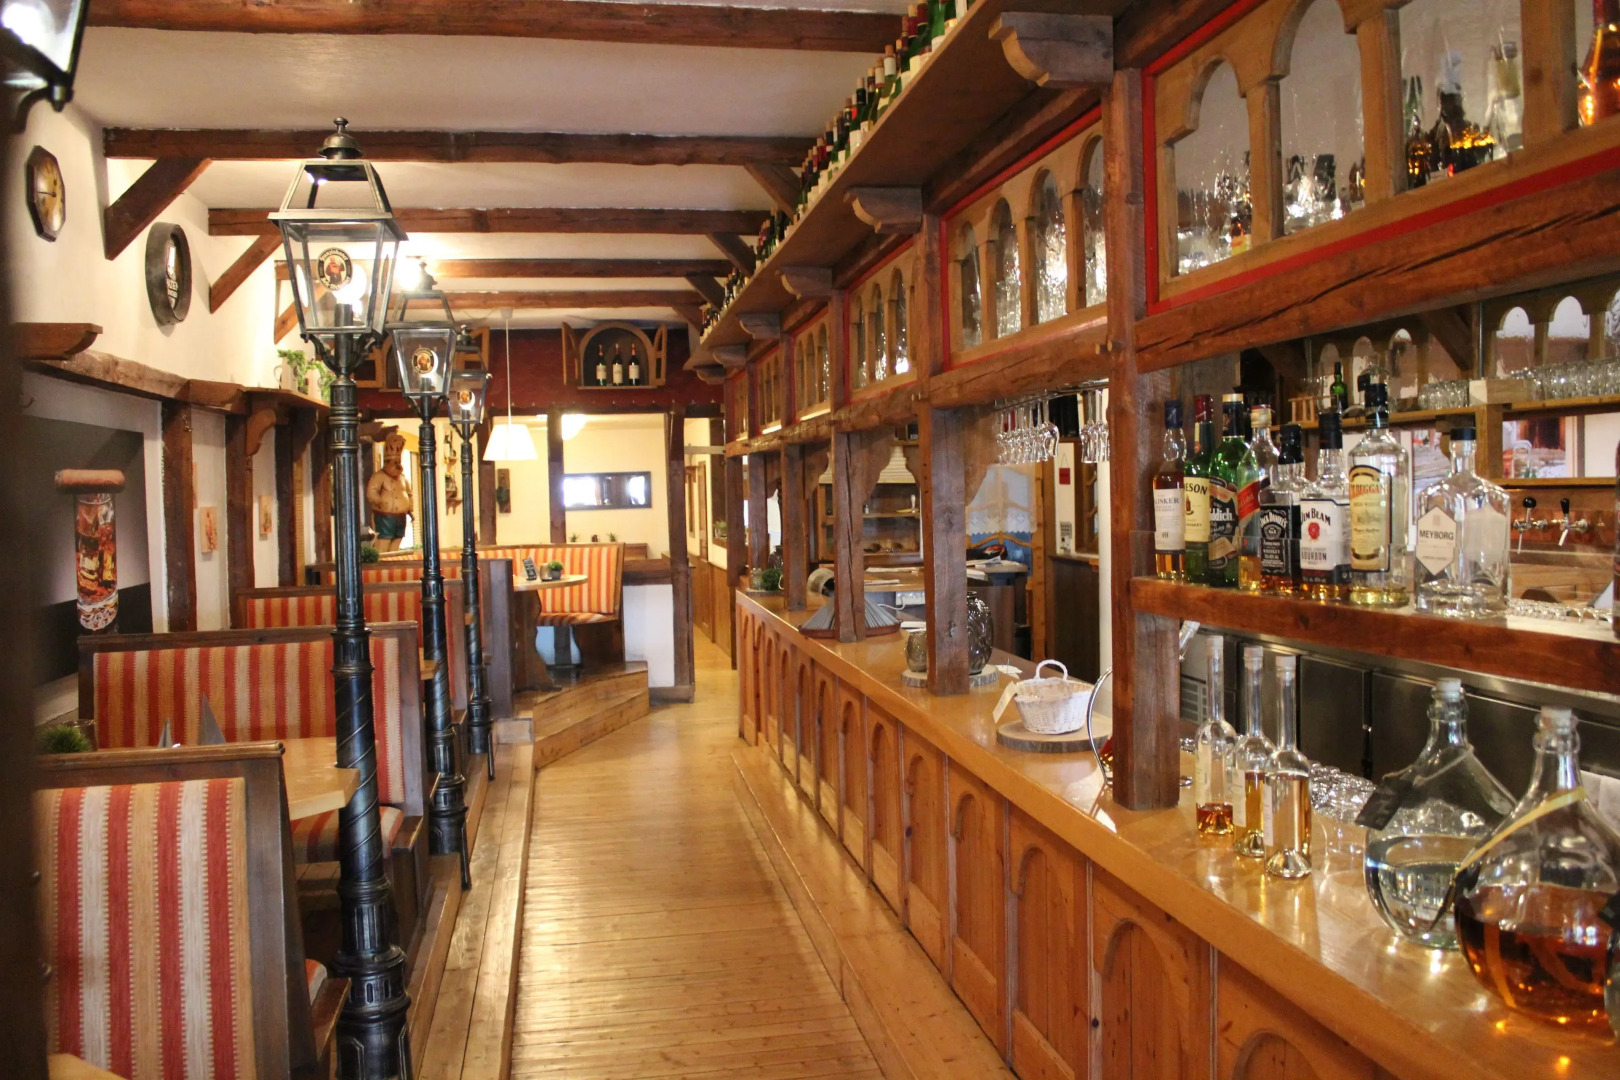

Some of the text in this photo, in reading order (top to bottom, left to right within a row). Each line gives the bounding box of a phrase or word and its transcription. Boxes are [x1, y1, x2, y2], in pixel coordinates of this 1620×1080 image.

[1185, 482, 1208, 495] ESON
[1210, 508, 1233, 521] ddich
[1301, 507, 1331, 526] JIM BEAM
[1419, 529, 1454, 540] MEYBORG
[1301, 551, 1327, 561] BOURBON
